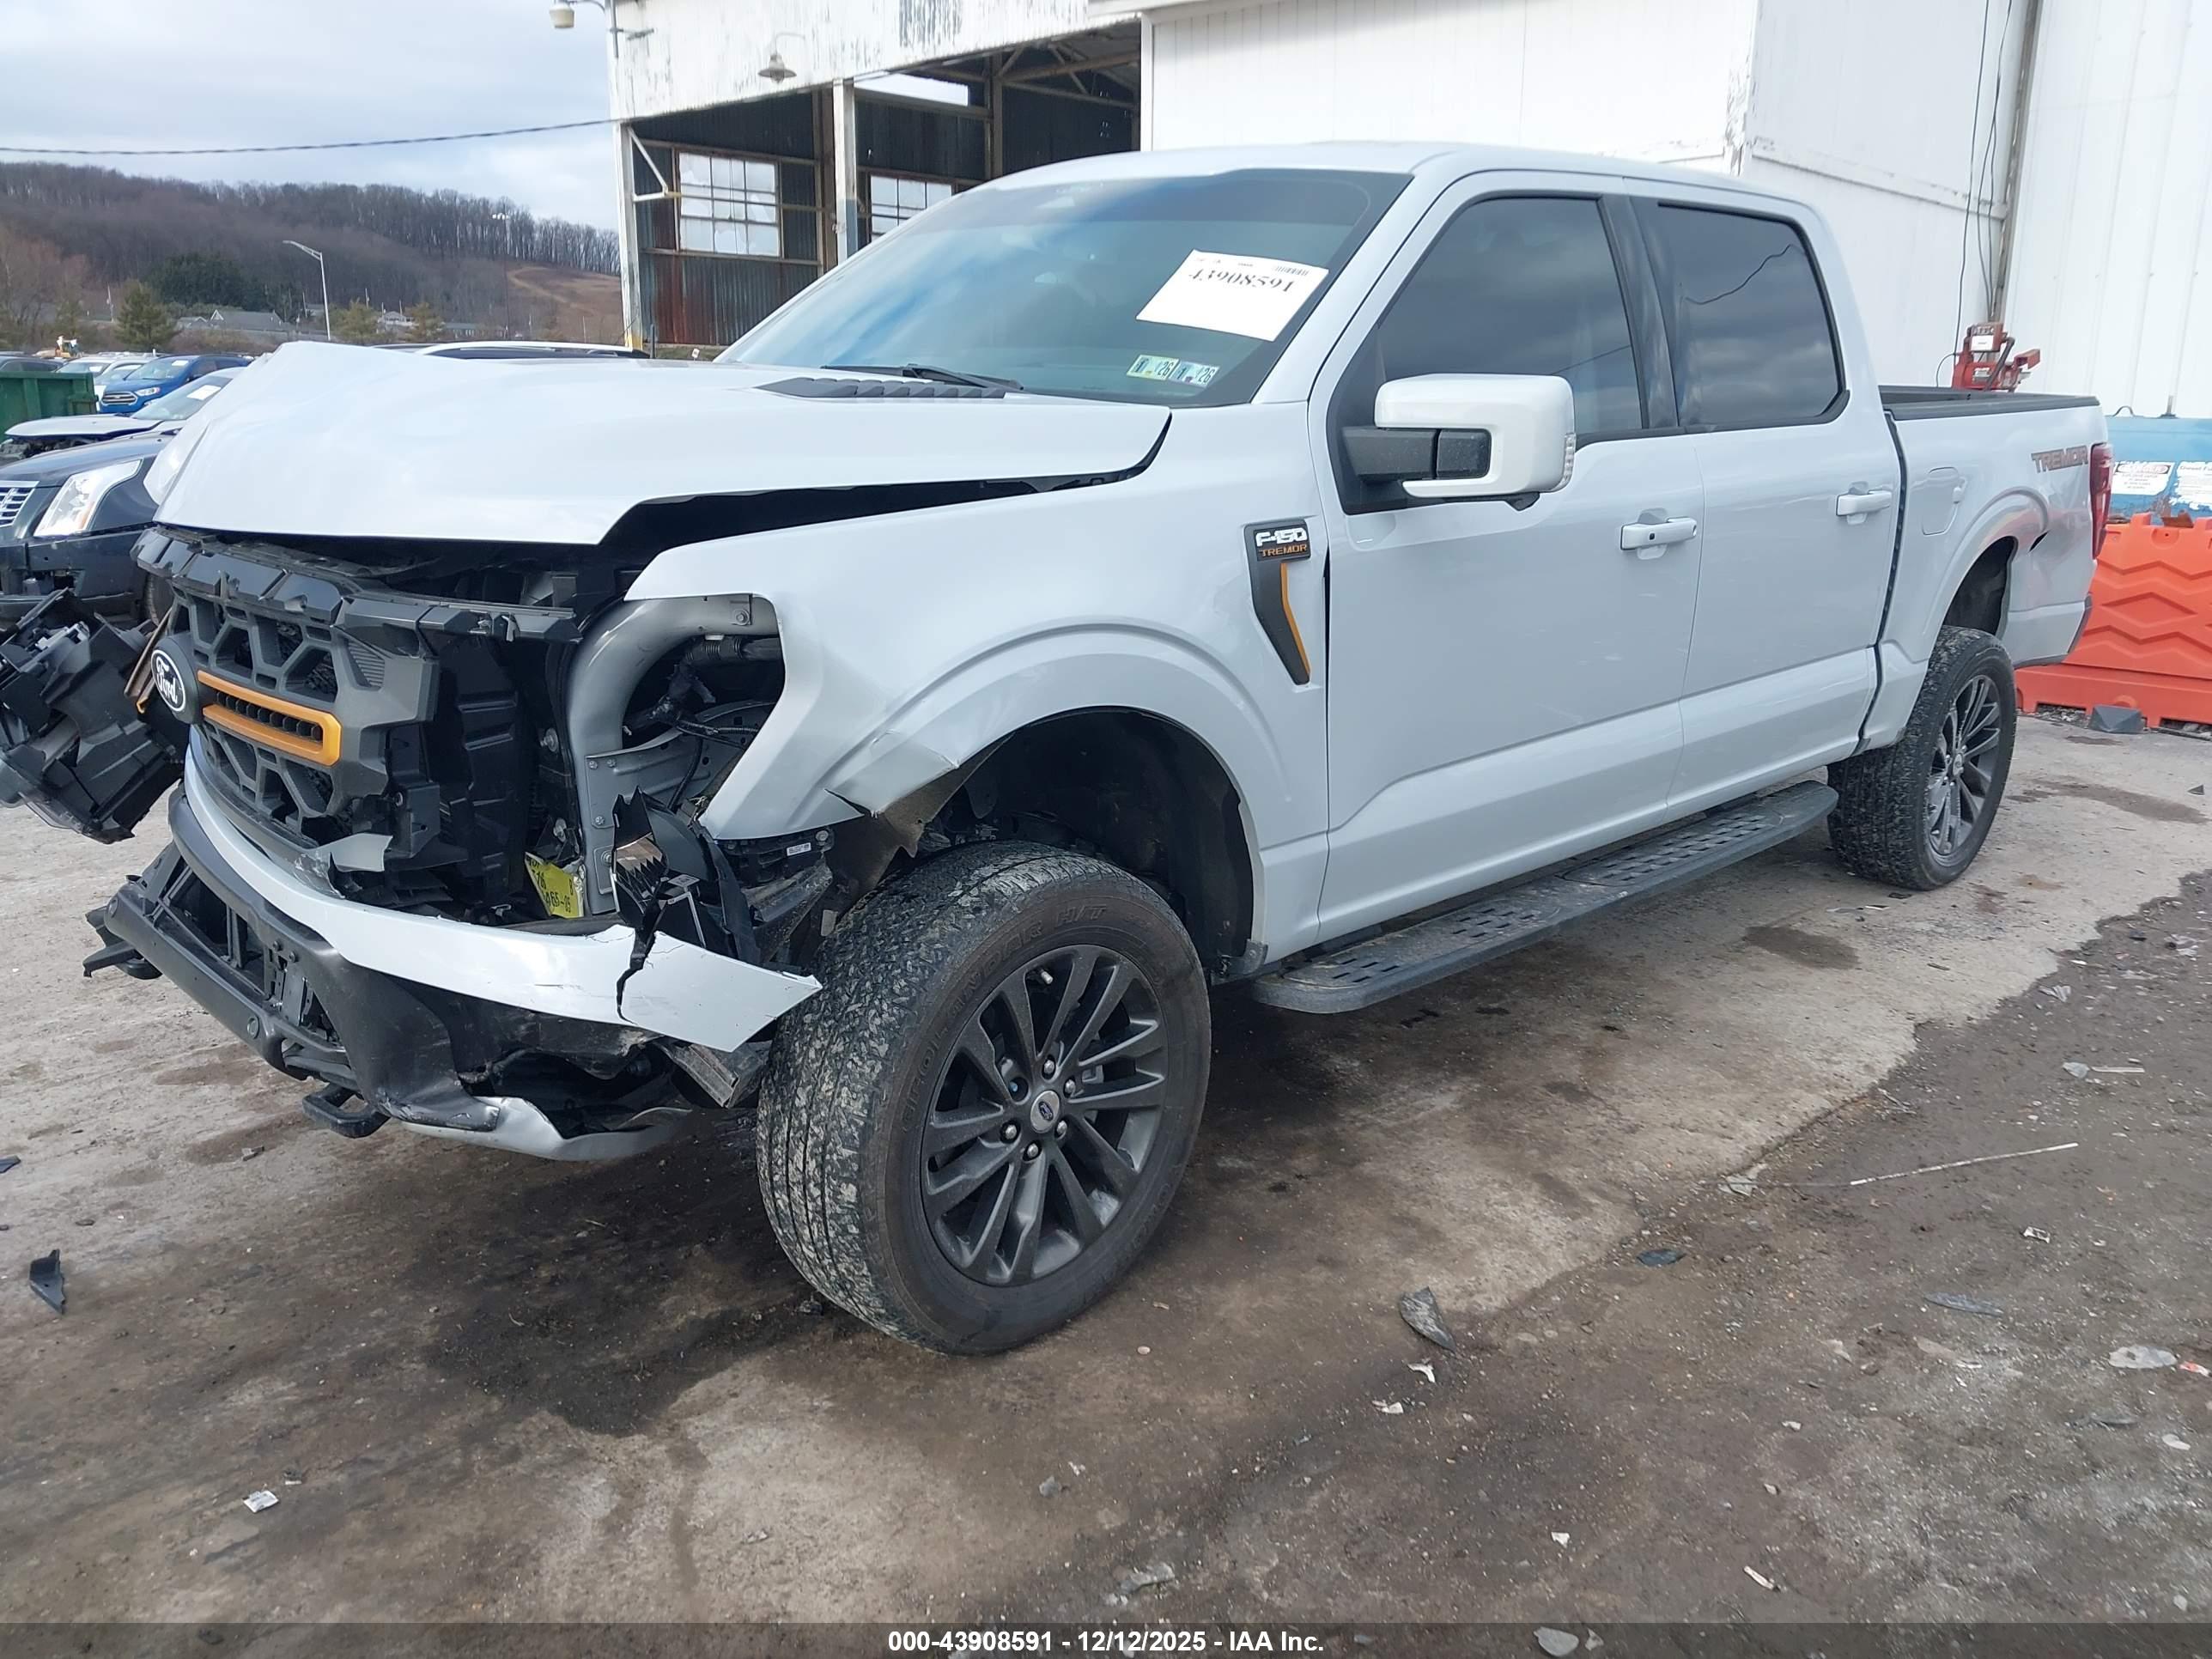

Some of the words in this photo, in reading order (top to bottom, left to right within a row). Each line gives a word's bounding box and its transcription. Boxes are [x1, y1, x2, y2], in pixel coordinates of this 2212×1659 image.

[1188, 268, 1295, 293] 43908591
[2031, 445, 2089, 473] TREMOR
[1255, 526, 1308, 547] F-150
[1258, 544, 1307, 557] TREMOR
[155, 654, 180, 706] Ford
